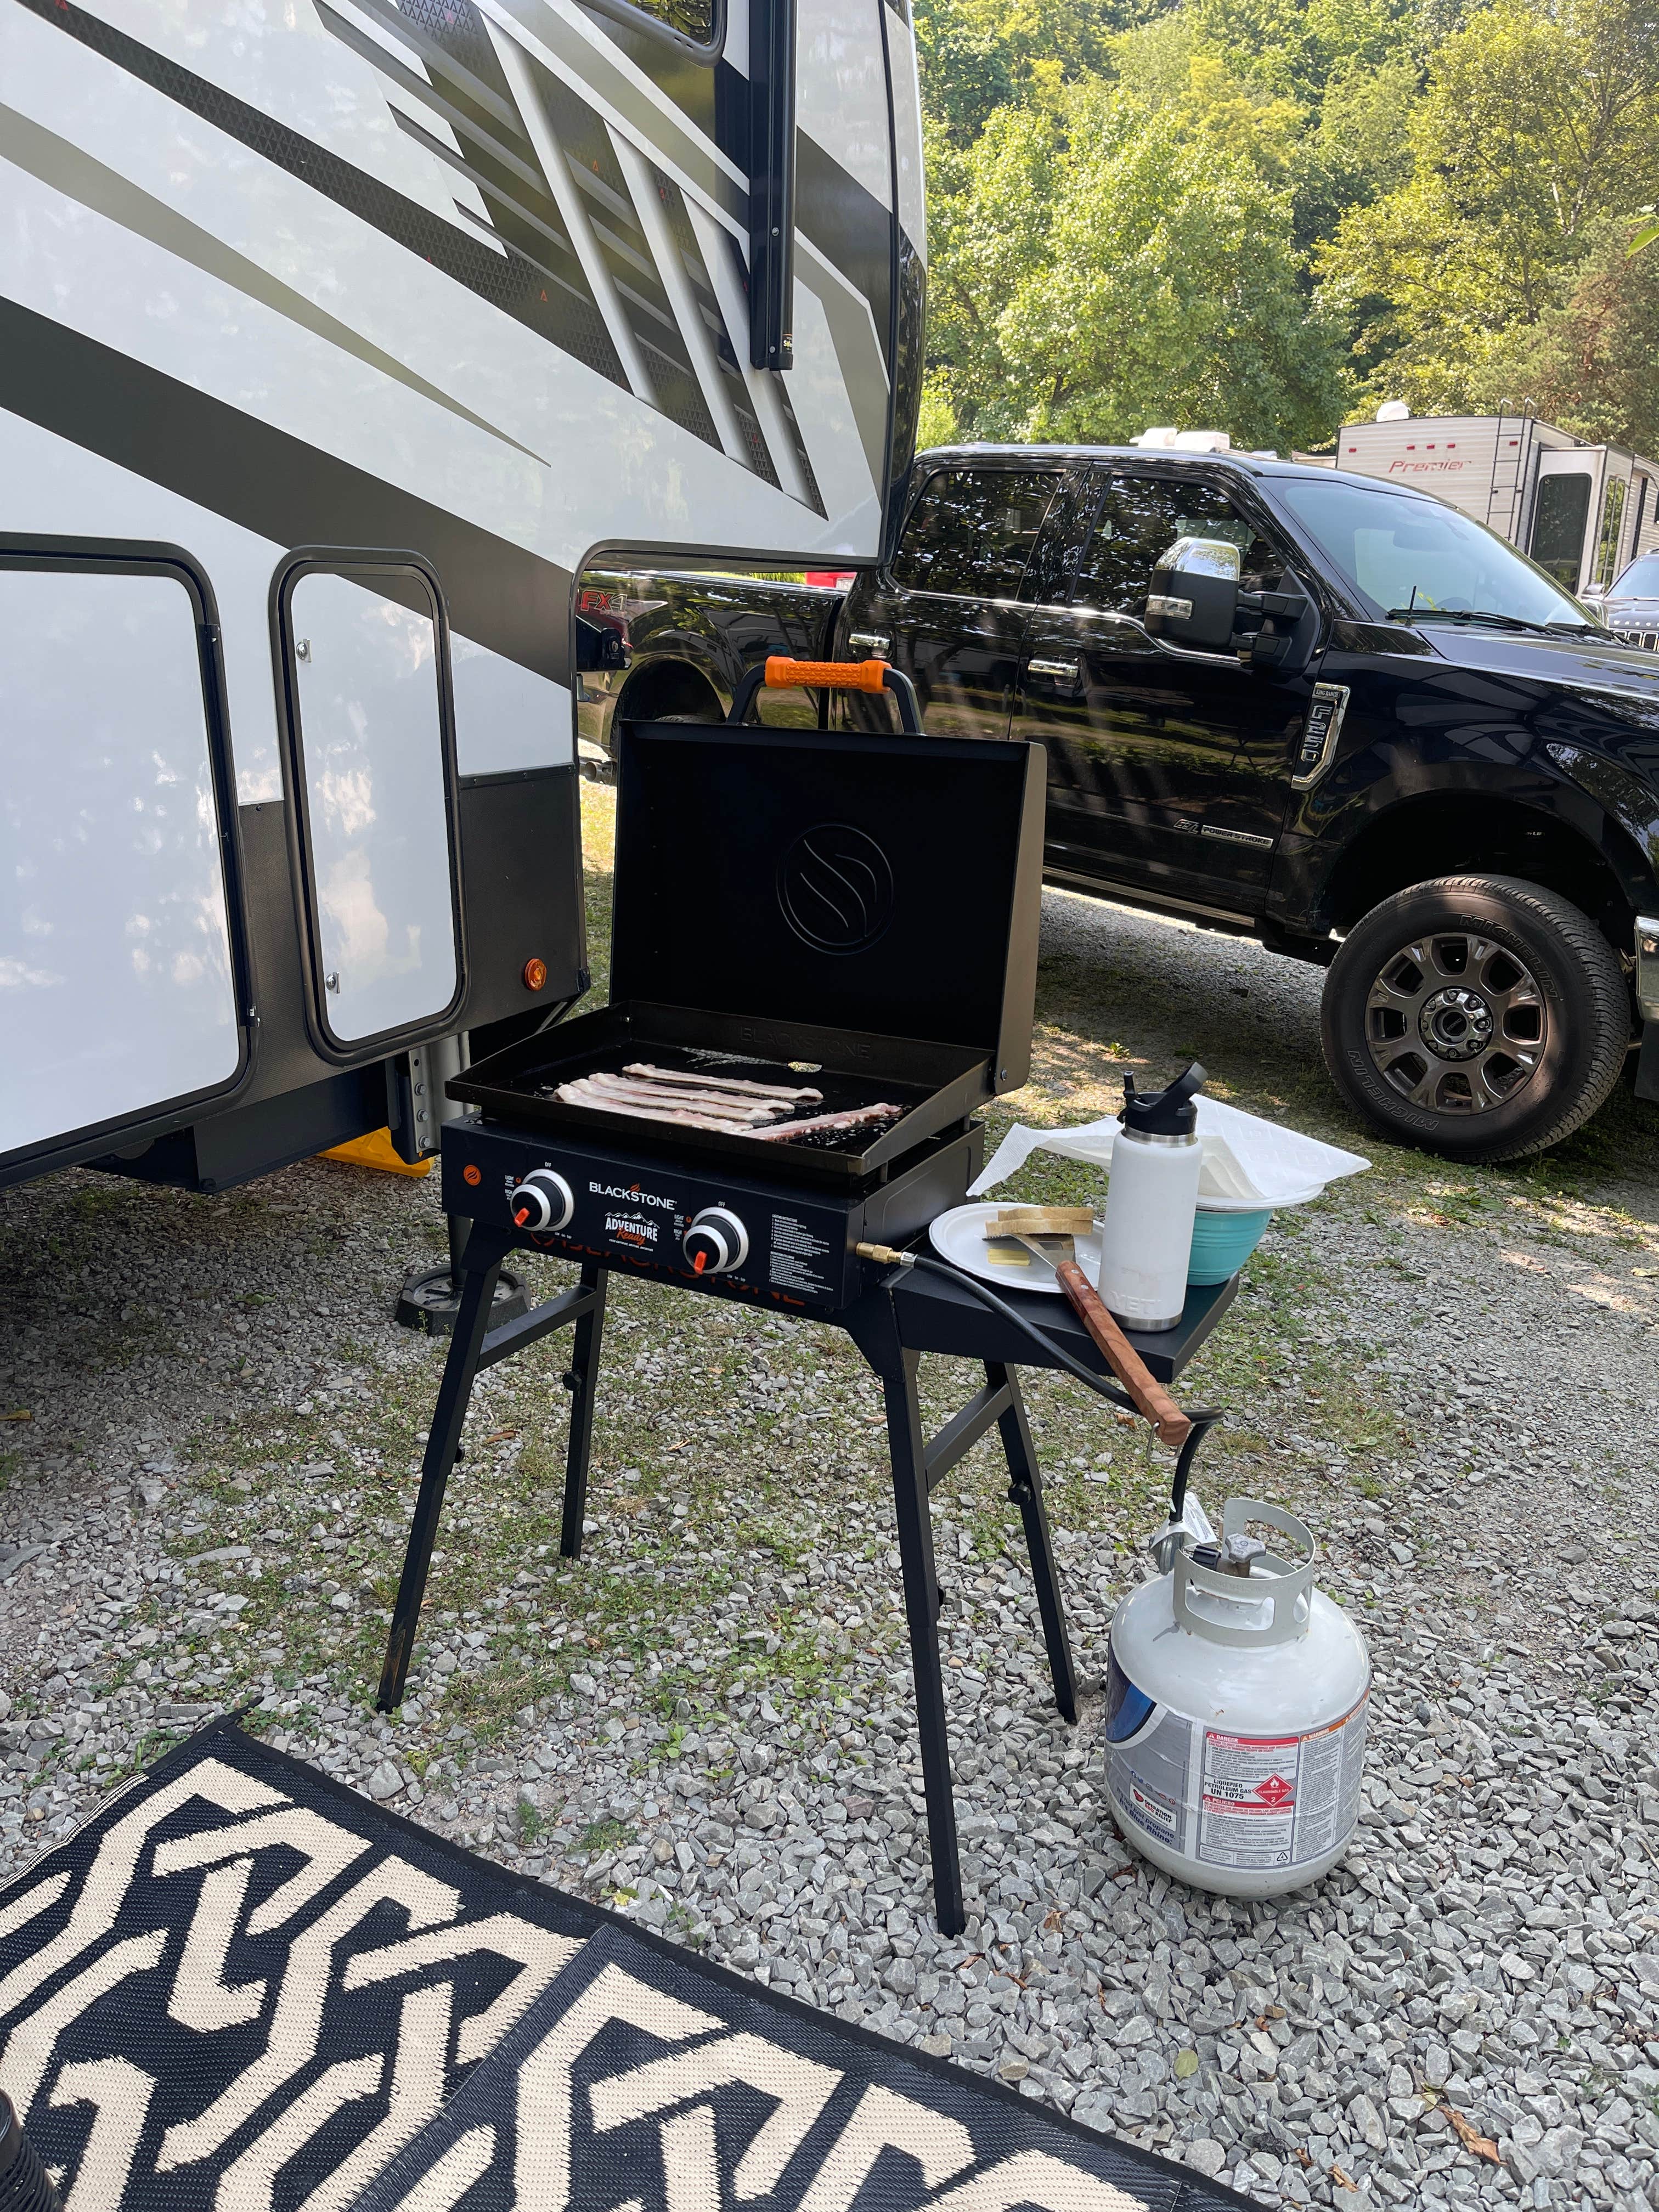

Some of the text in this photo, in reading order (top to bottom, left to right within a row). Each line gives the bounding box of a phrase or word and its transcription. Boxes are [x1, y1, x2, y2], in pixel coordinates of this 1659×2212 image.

[1389, 459, 1471, 473] Premier
[580, 590, 628, 611] FX4
[1203, 827, 1233, 837] POWER
[1233, 832, 1271, 844] STROKE
[1459, 915, 1559, 998] MICHELIN
[1348, 1049, 1439, 1131] MICHELIN
[589, 1182, 675, 1210] BLACKSTONE
[605, 1217, 658, 1242] ADVENTURE
[616, 1227, 646, 1245] Ready
[1111, 1290, 1163, 1315] YETI
[1216, 1735, 1238, 1743] DANGER
[1309, 1728, 1329, 1739] WARNING
[1204, 1781, 1238, 1793] PETROLEUM
[1214, 1779, 1243, 1788] LIQUEFIED
[1125, 1798, 1133, 1807] not
[1133, 1805, 1144, 1819] just
[1129, 1810, 1144, 1826] Blue
[1145, 1799, 1171, 1819] OPERATION
